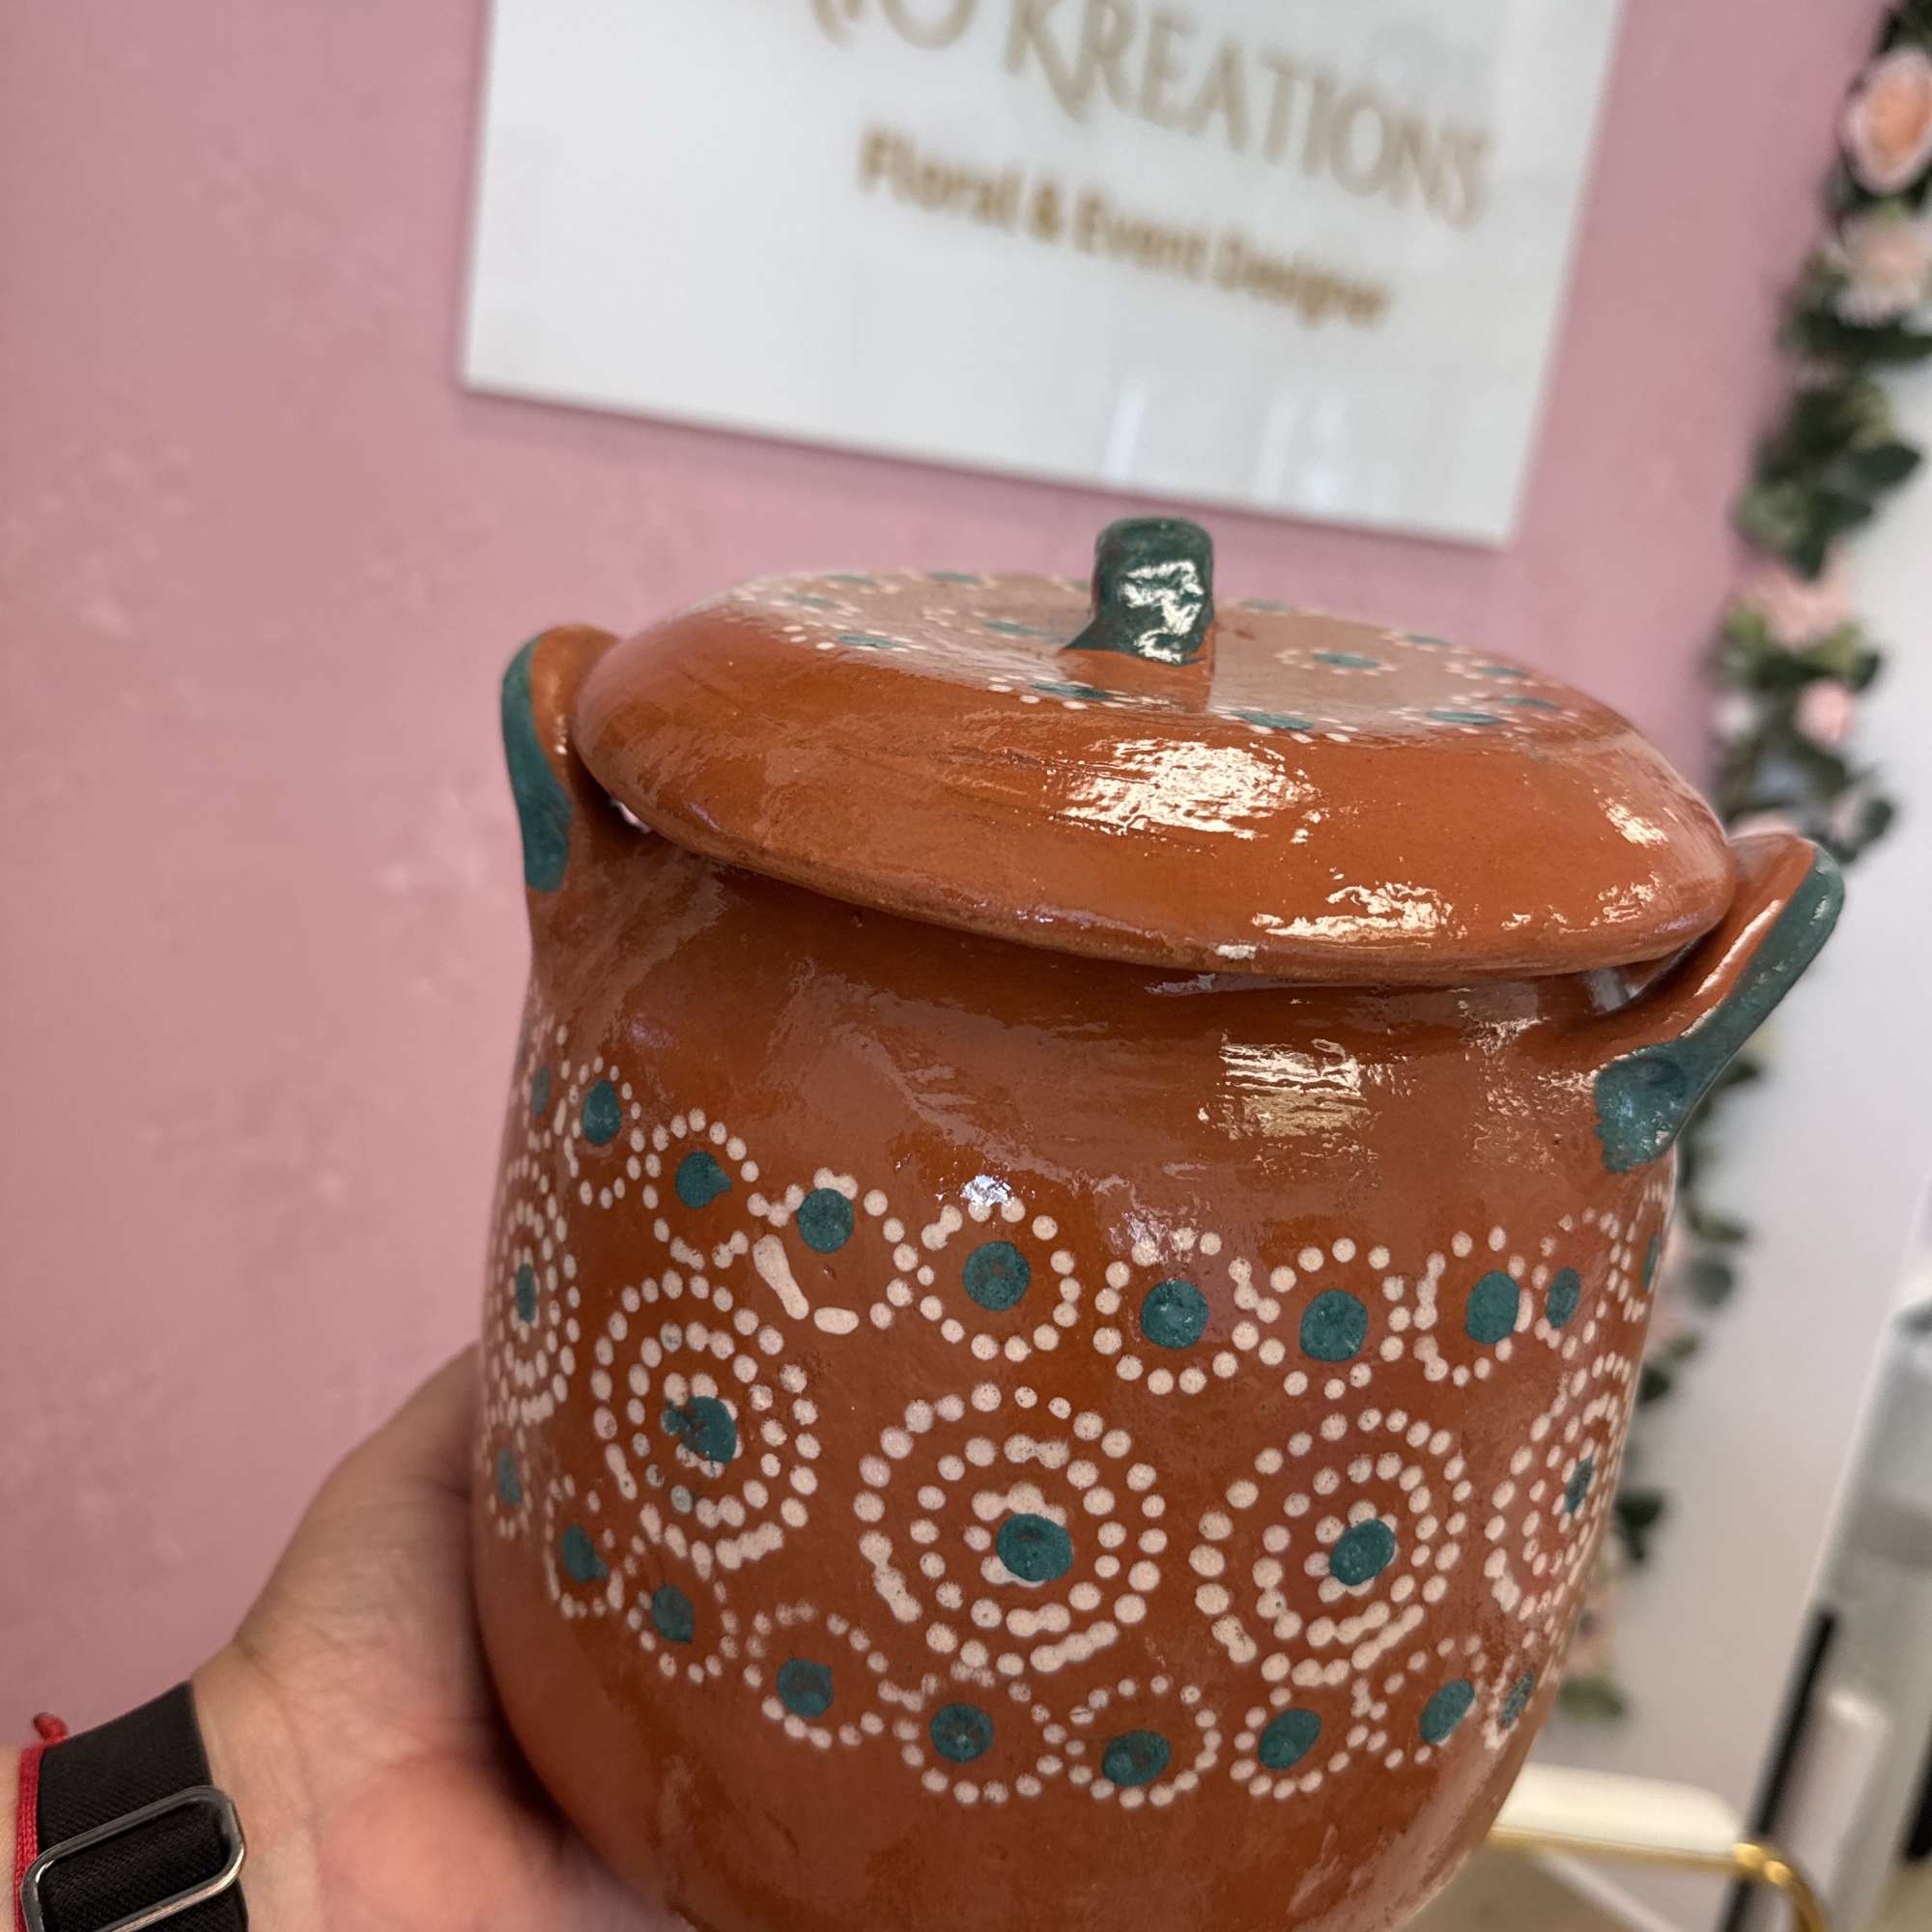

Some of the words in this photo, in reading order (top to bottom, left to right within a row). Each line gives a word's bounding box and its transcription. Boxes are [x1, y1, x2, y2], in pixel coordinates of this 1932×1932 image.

[859, 127, 1020, 231] Floral
[1027, 180, 1062, 242] &
[1071, 190, 1208, 280] Event
